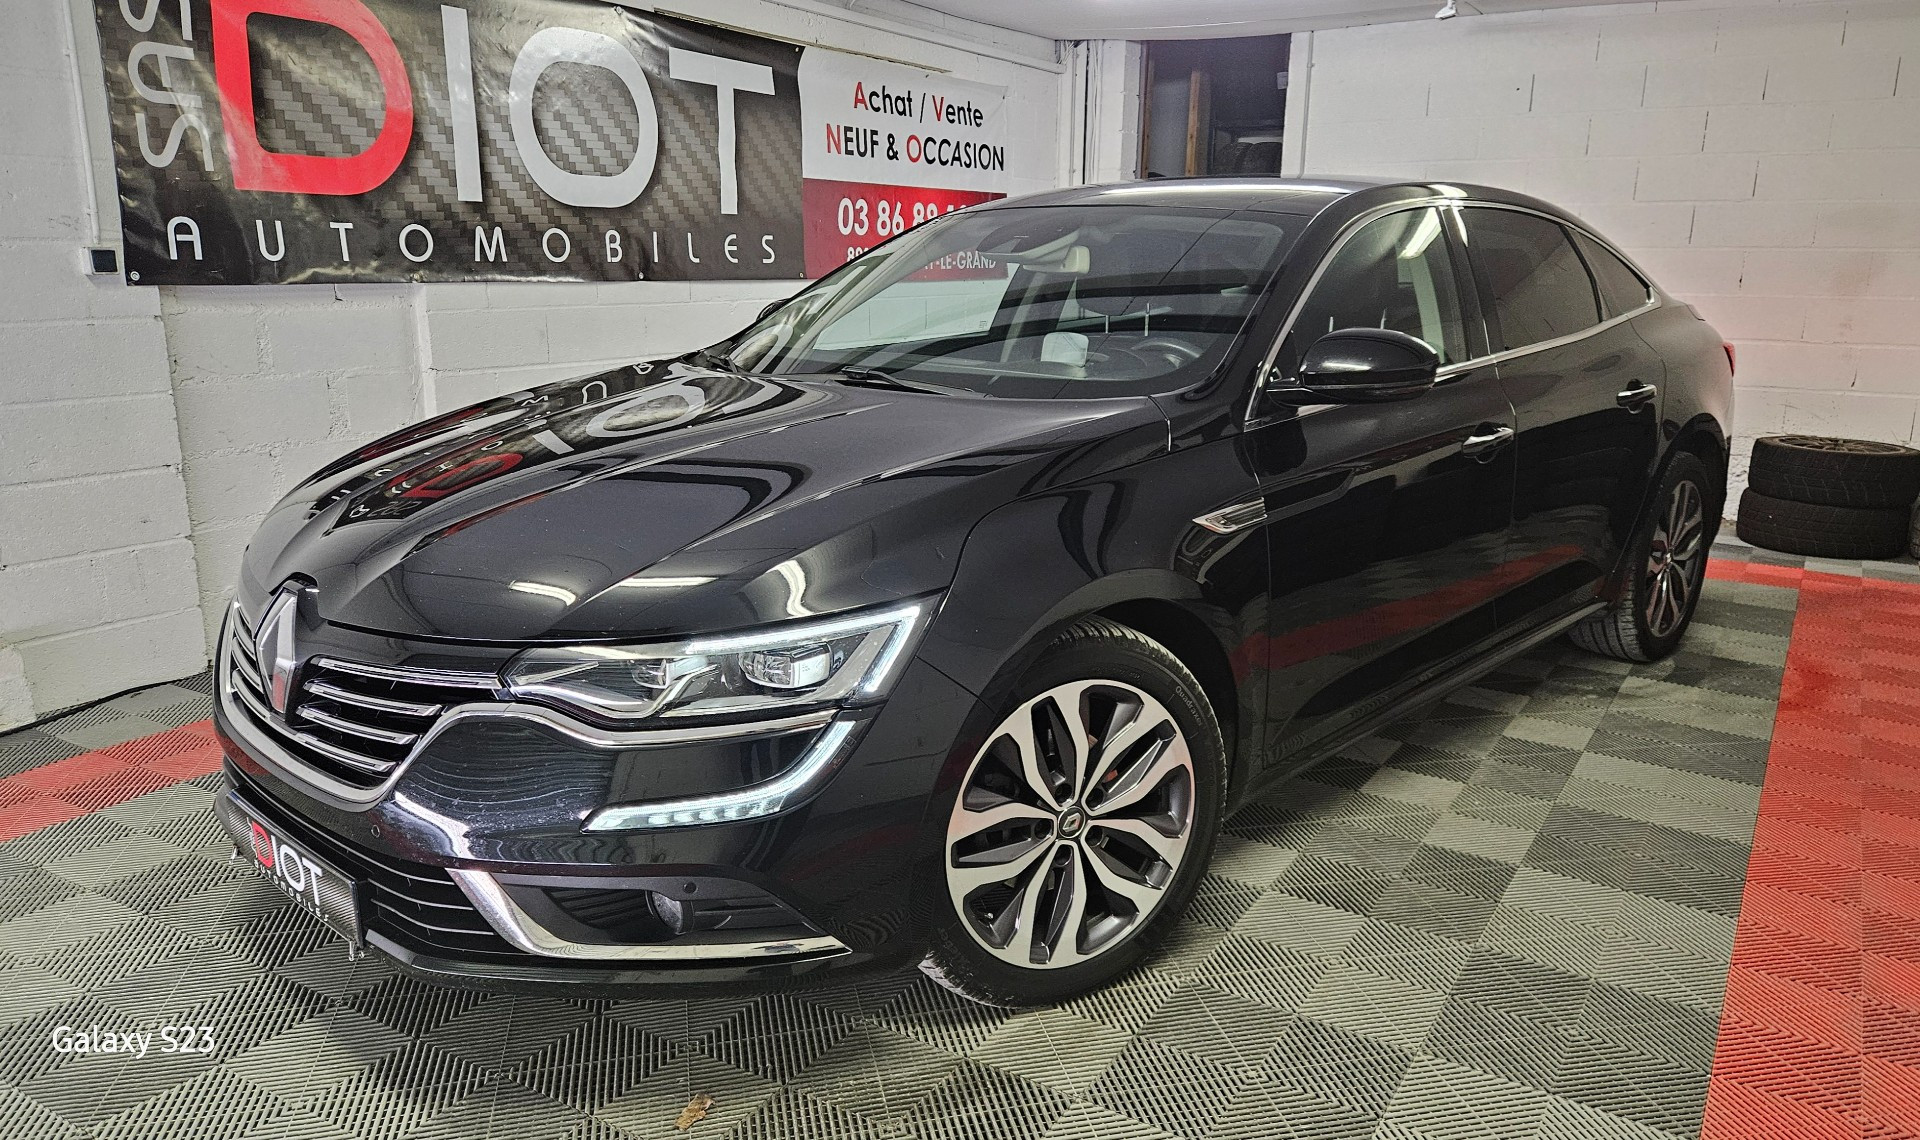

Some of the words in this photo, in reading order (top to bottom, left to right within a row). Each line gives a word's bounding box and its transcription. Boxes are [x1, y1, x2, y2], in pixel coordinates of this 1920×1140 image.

[210, 0, 776, 215] DIOT
[853, 81, 913, 118] Achat
[931, 94, 984, 128] Vente
[825, 123, 880, 158] NEUF
[886, 132, 900, 161] &
[905, 133, 1005, 172] OCCASION
[166, 215, 776, 264] AUTOMOBILES
[838, 197, 869, 236] 03
[876, 199, 905, 237] 86
[252, 820, 323, 907] DIOT
